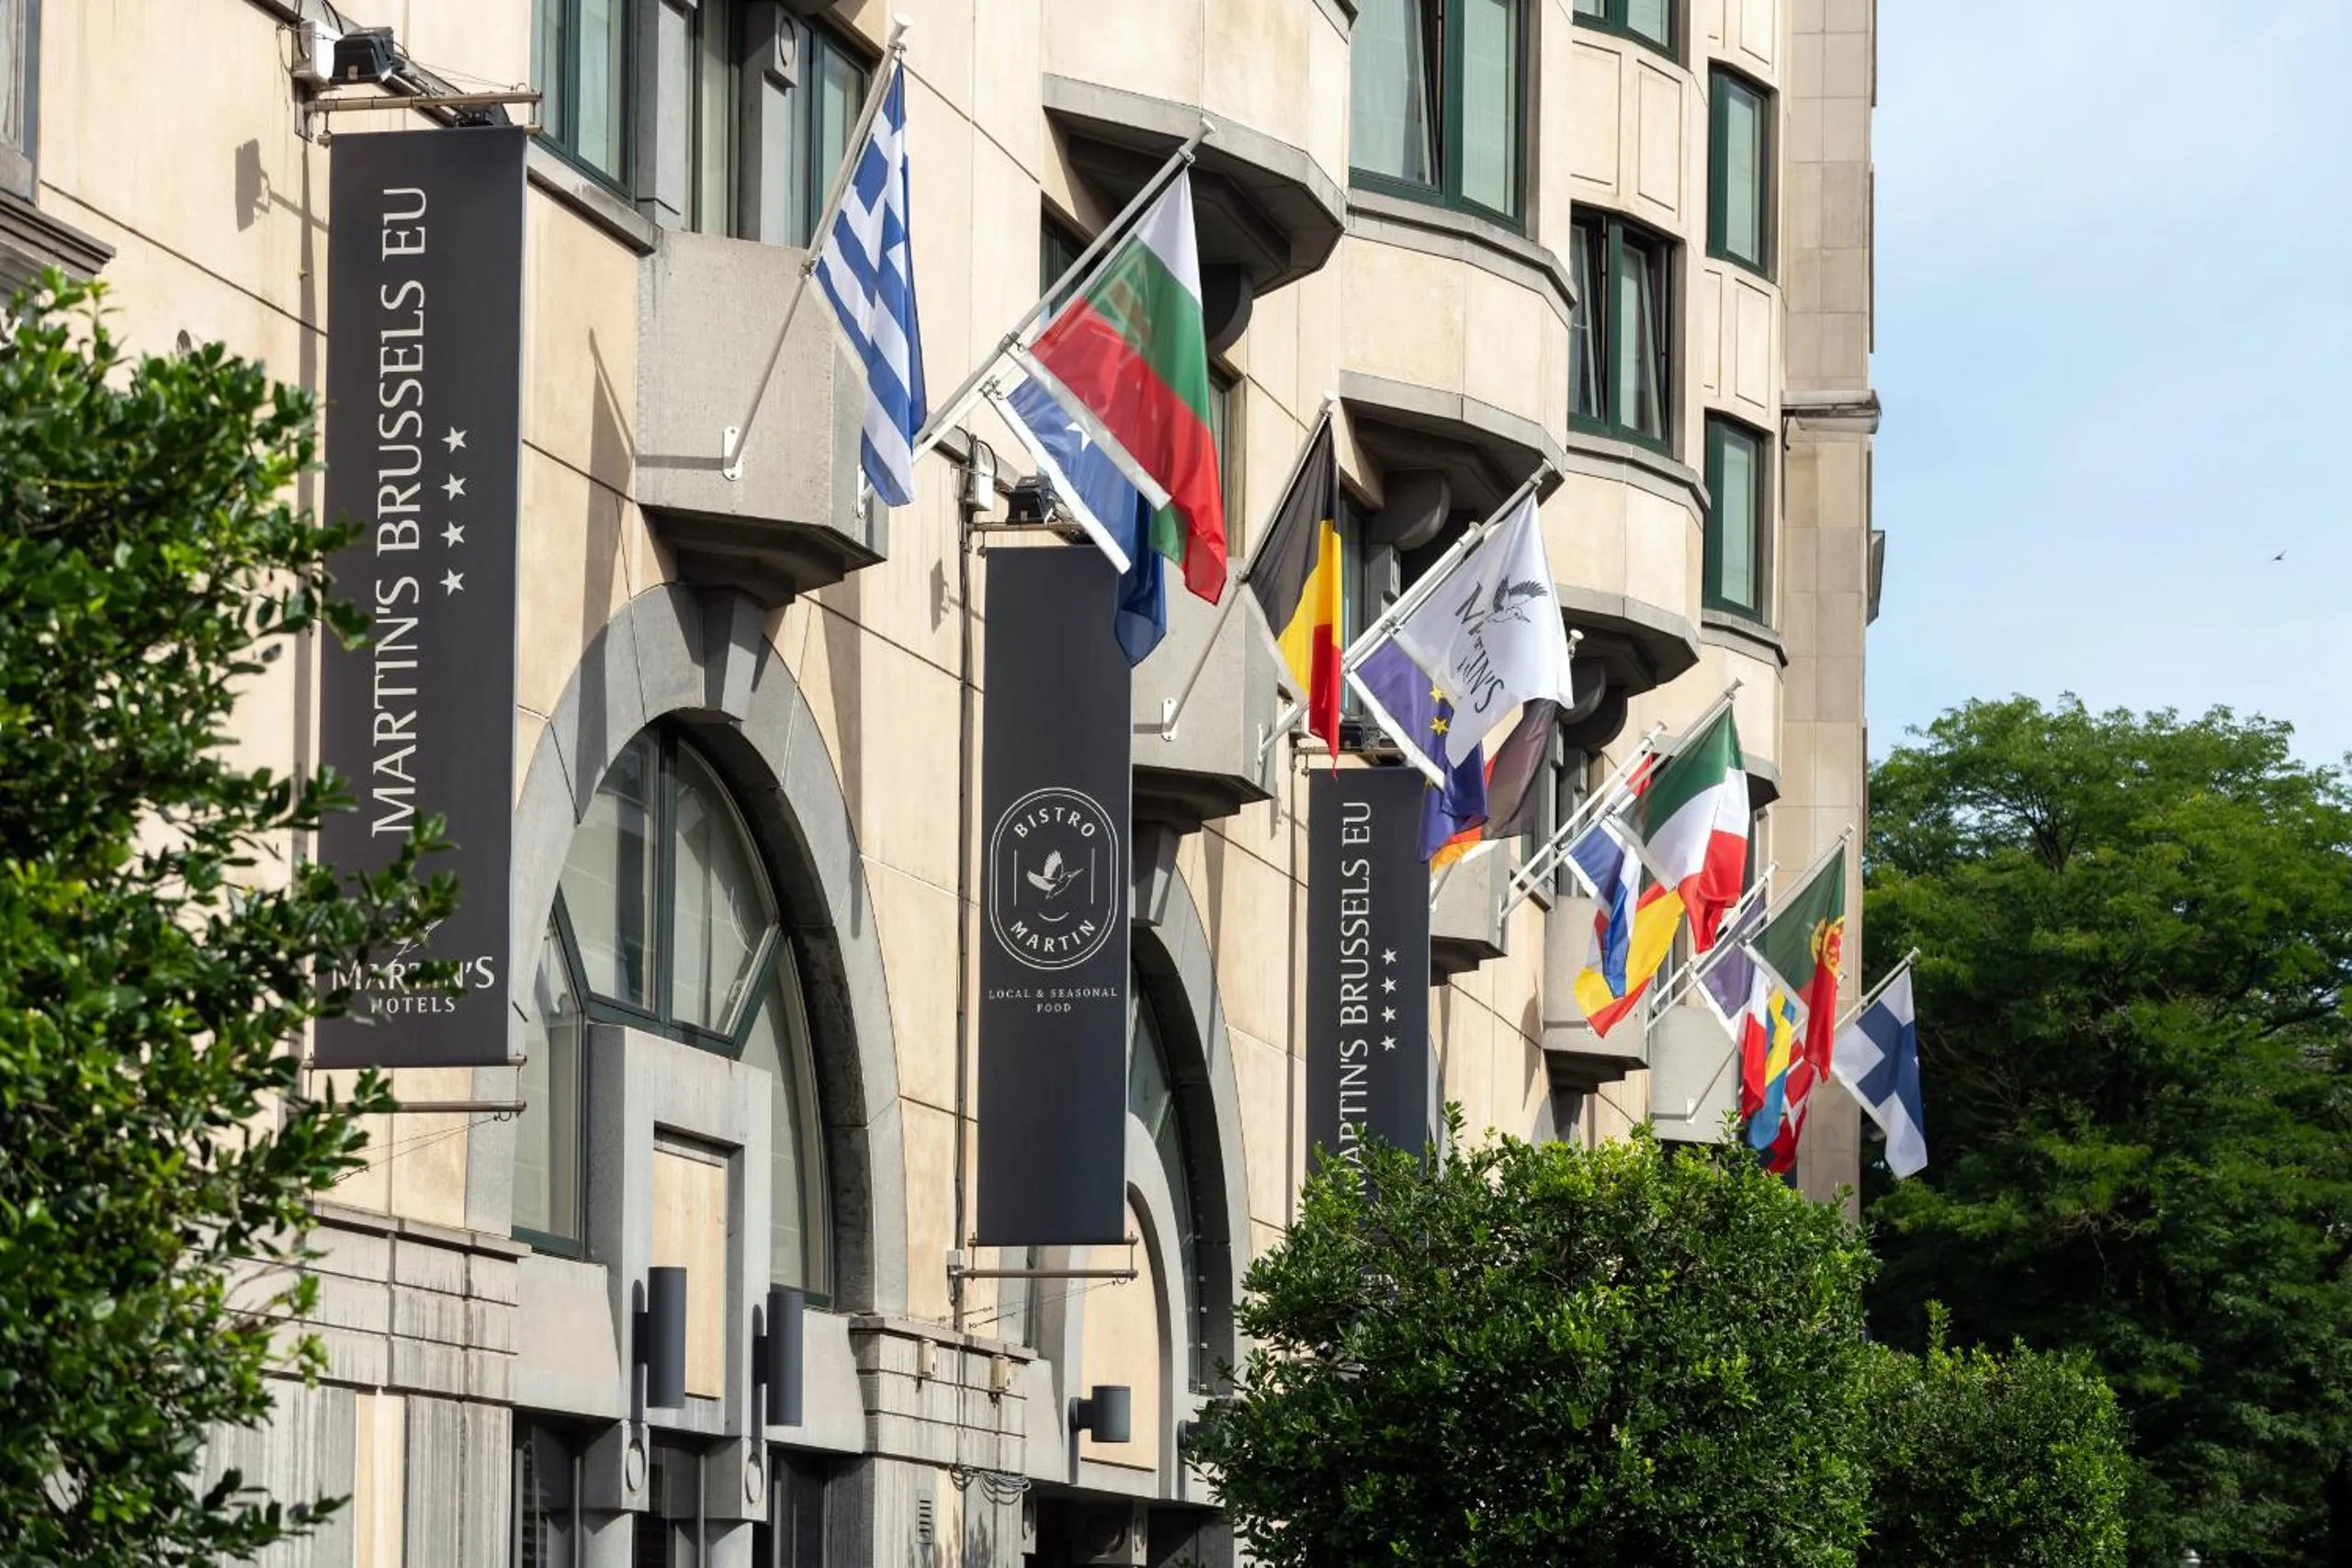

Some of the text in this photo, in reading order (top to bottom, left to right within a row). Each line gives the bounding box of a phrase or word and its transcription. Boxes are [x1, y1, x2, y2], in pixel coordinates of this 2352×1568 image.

[371, 186, 427, 839] MARTIN'S BRUSSELS EU
[1013, 807, 1096, 839] BISTRO
[1341, 801, 1372, 847] EU
[1010, 919, 1097, 953] MARTIN
[1340, 858, 1370, 1028] BRUSSELS
[989, 987, 1118, 999] LOCAL & SEASONAL
[1035, 1002, 1072, 1013] FOOD
